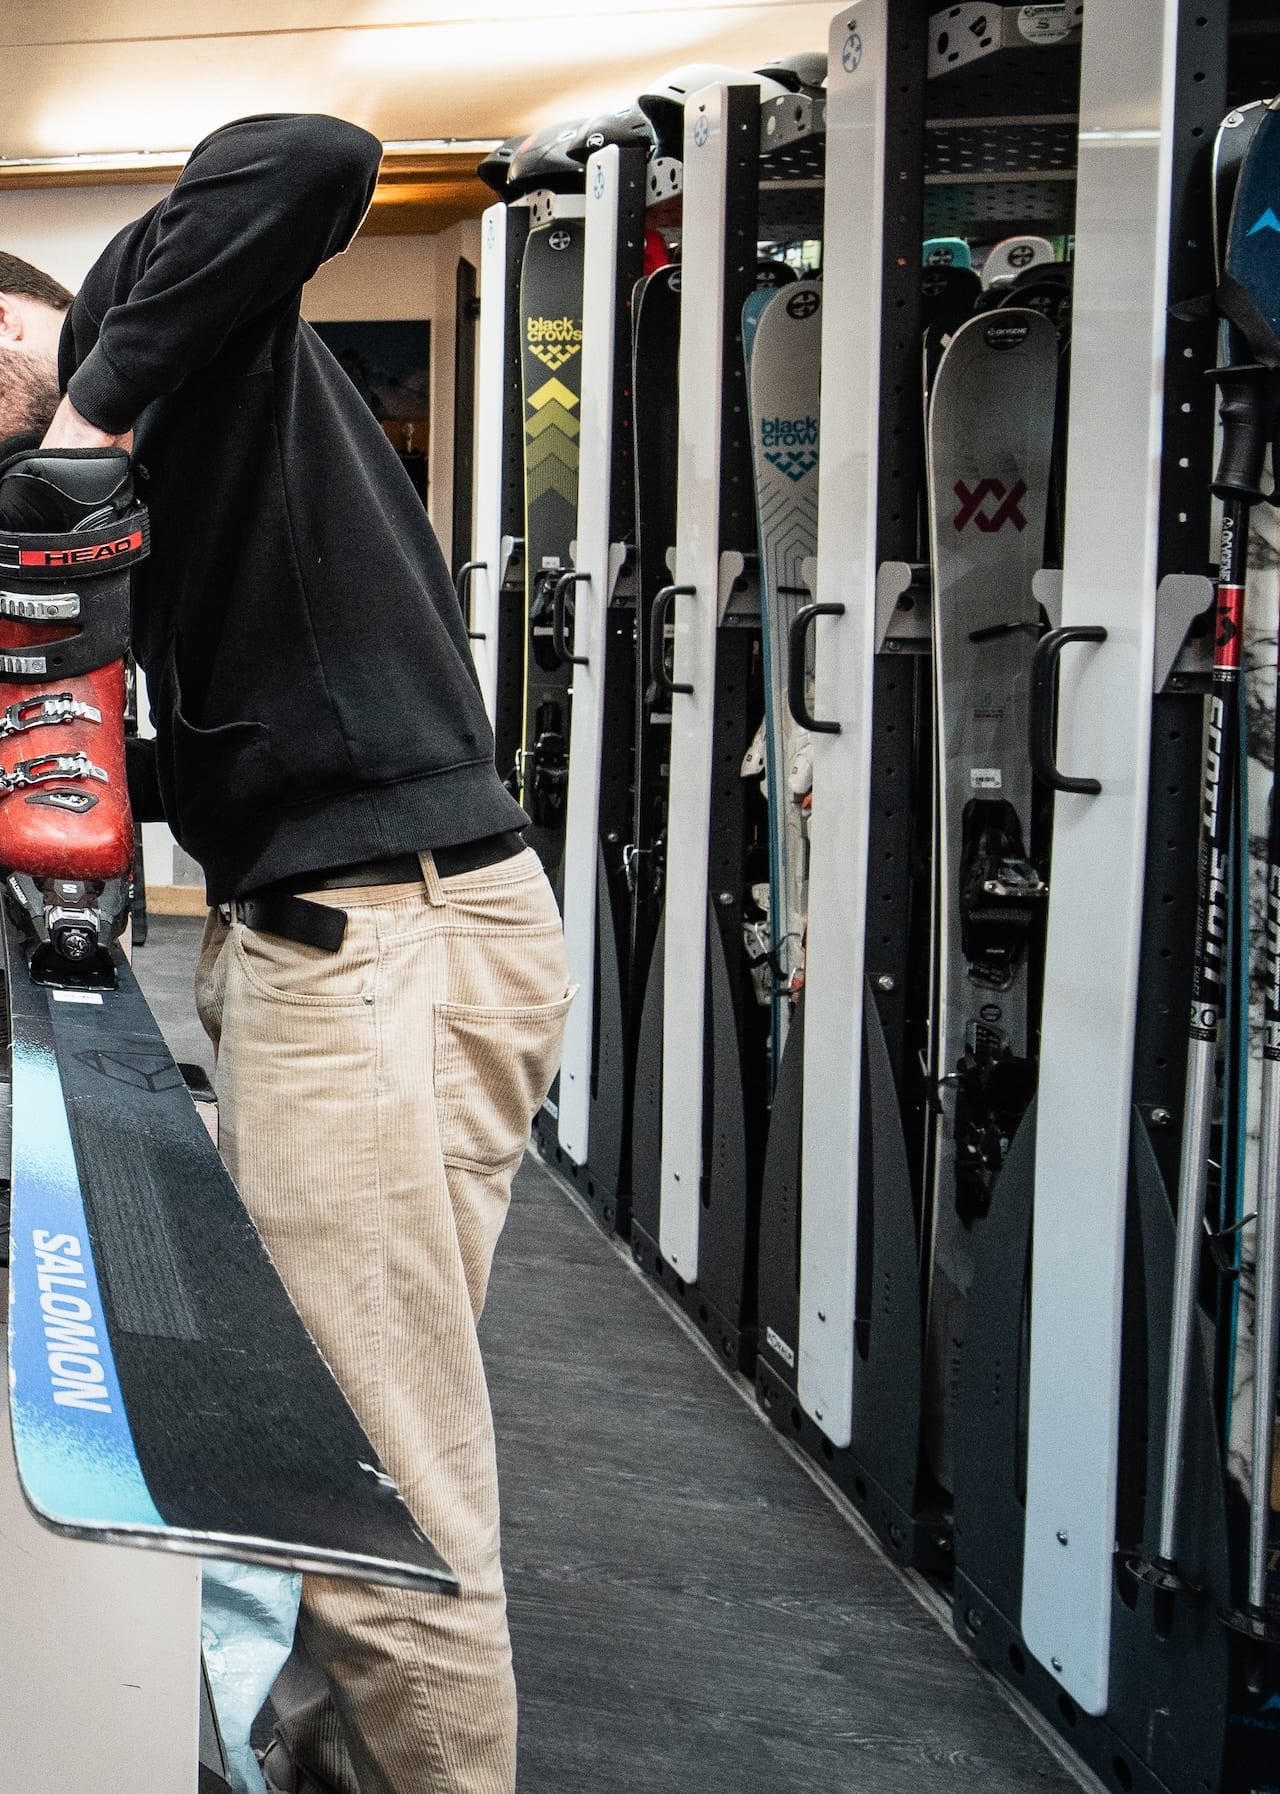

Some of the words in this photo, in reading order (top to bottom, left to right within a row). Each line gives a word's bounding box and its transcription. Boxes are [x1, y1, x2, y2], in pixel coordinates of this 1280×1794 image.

[527, 316, 574, 331] black
[995, 328, 1028, 336] OXYGENE
[527, 330, 583, 341] crows
[761, 416, 817, 434] black
[762, 431, 818, 447] crow
[45, 539, 131, 565] HEAD
[1220, 531, 1233, 582] OXYGENE
[1204, 695, 1224, 838] SCOTT
[9, 876, 28, 905] SALOMON
[32, 1228, 112, 1414] SALOMON
